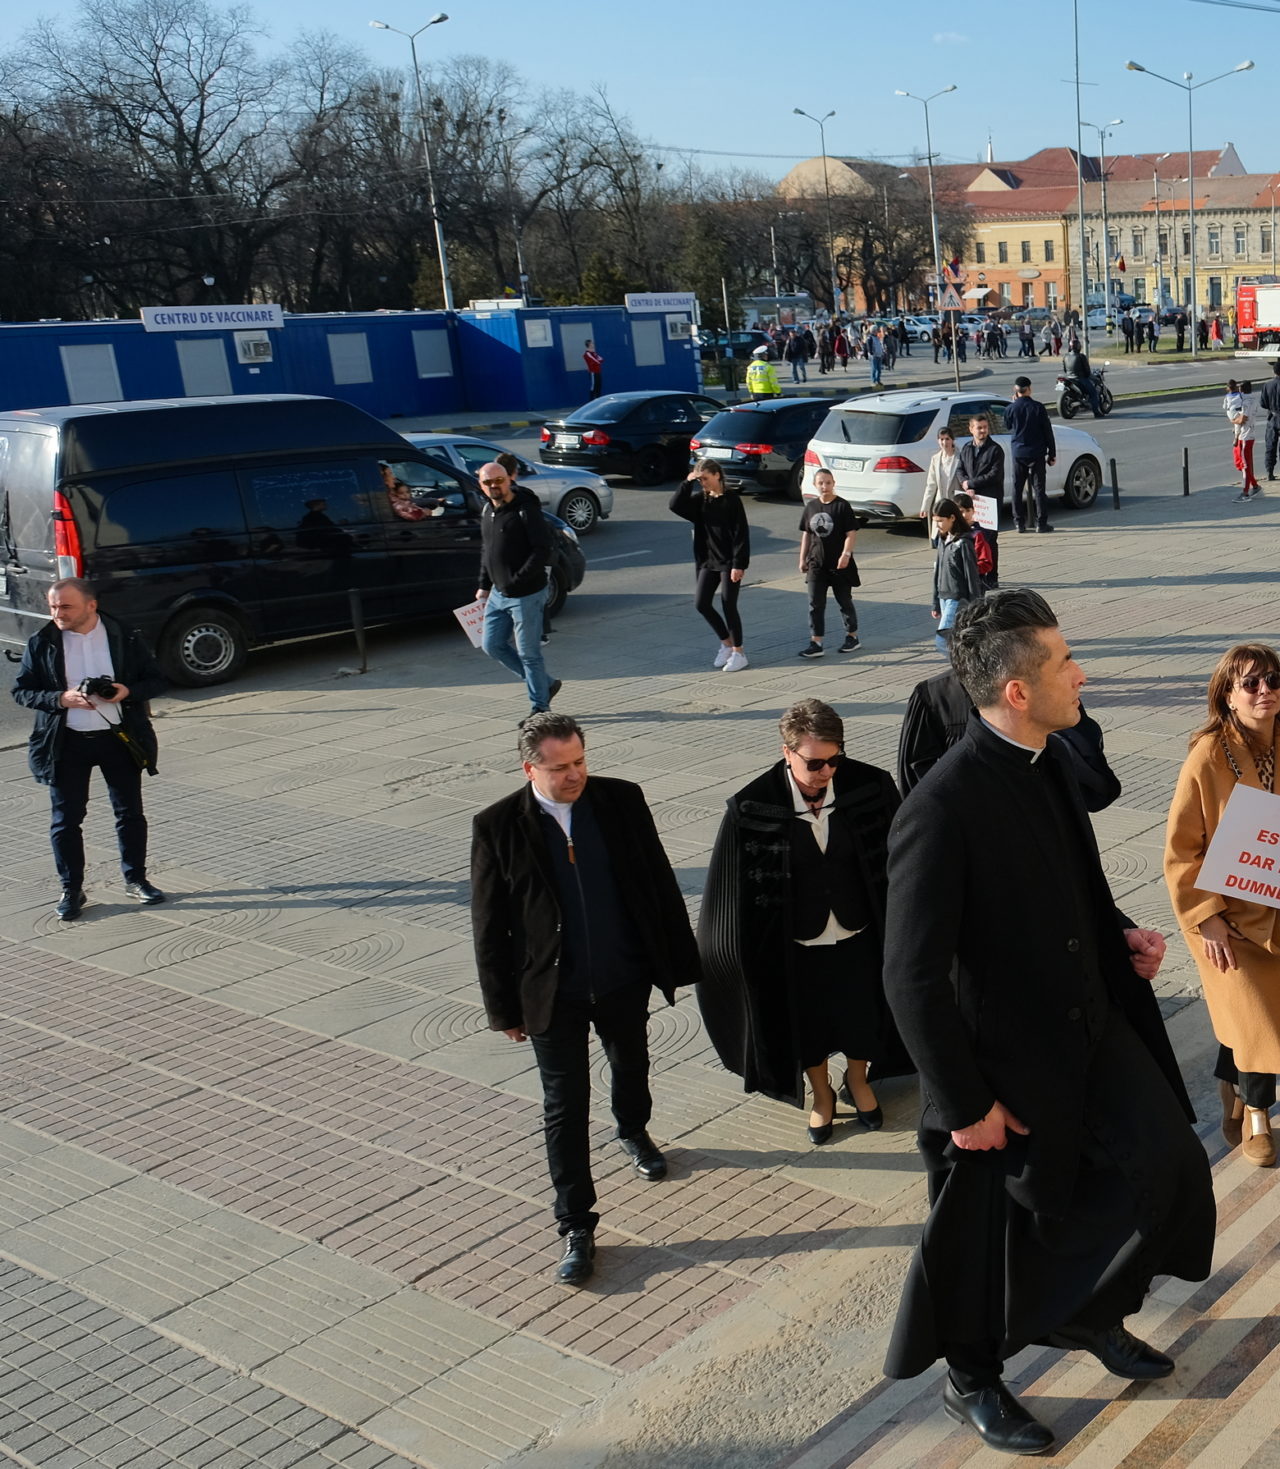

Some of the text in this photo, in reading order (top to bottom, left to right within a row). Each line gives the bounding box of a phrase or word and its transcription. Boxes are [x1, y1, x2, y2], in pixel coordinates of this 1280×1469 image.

[154, 310, 274, 325] CENTRU DE VACCINARE
[1238, 851, 1275, 871] DAR
